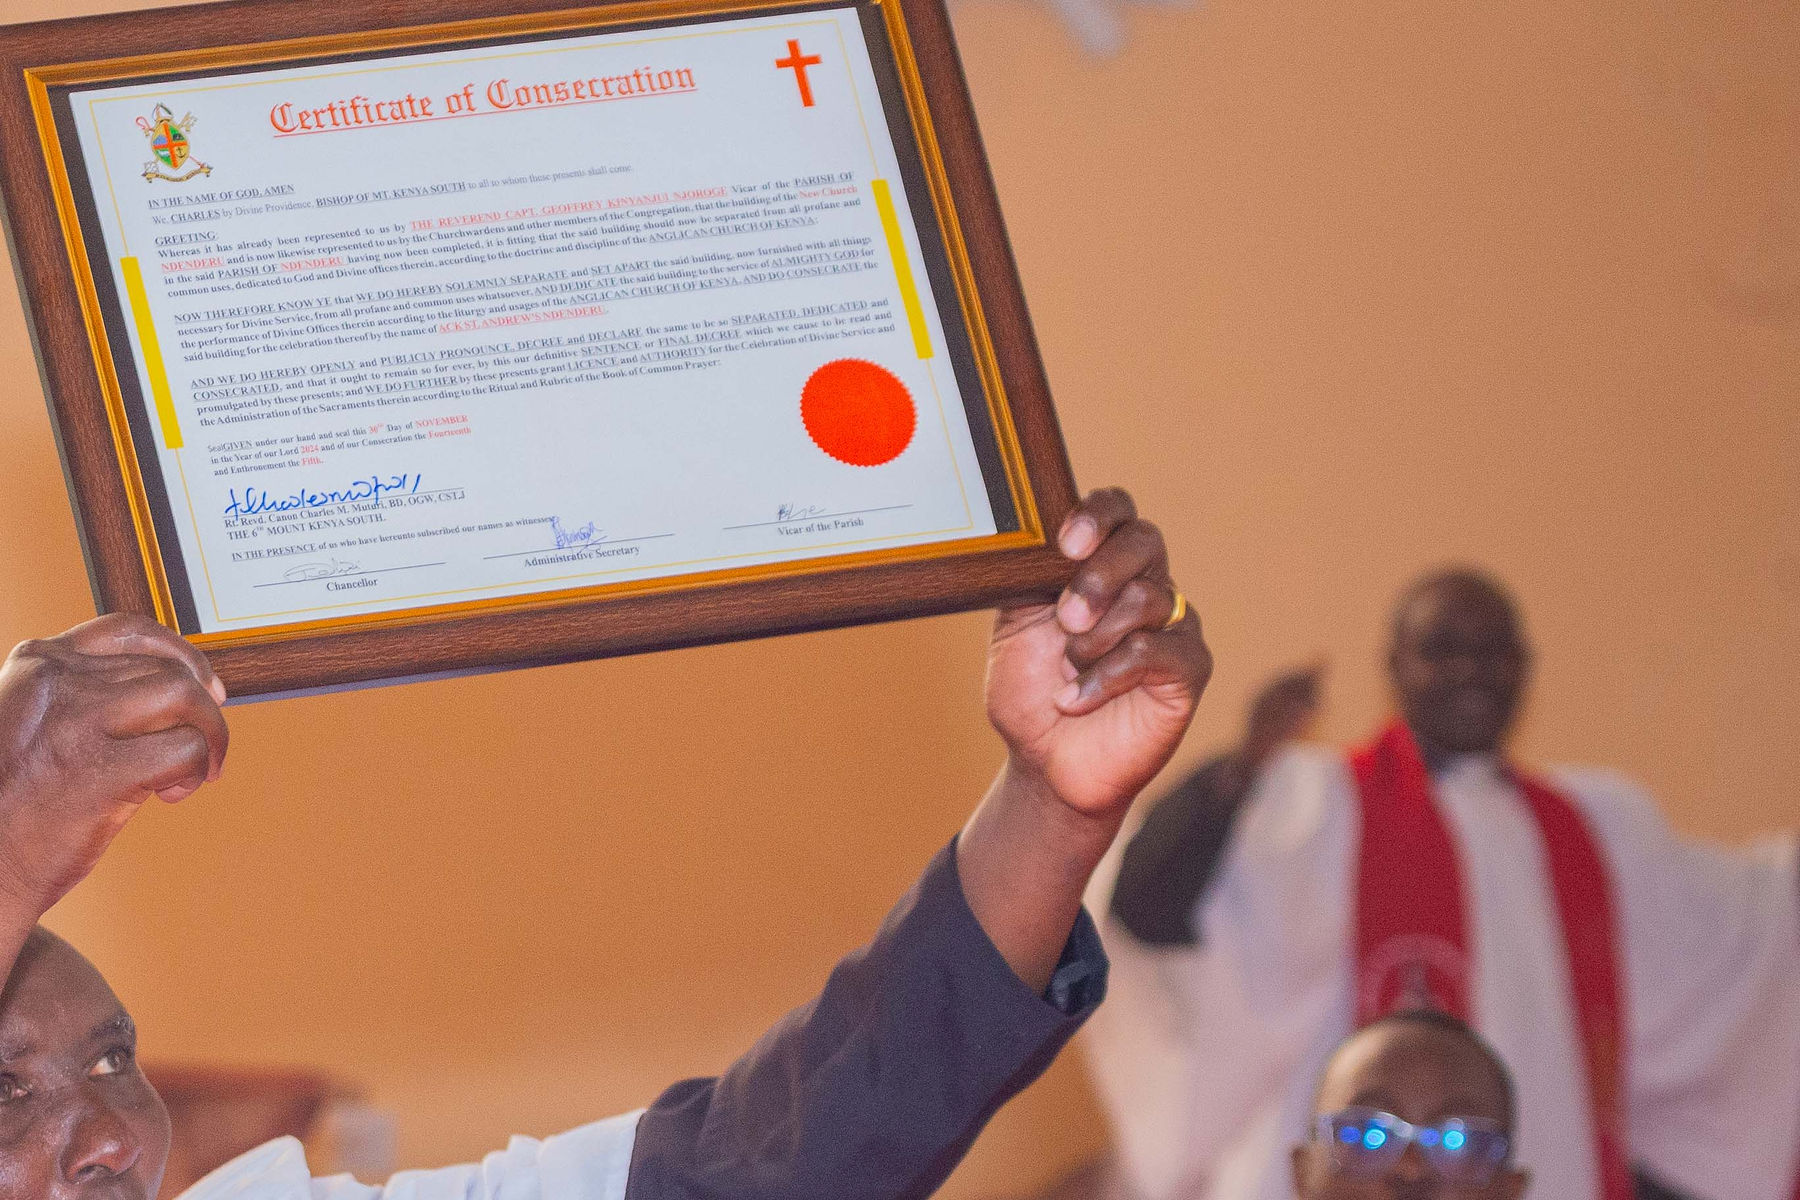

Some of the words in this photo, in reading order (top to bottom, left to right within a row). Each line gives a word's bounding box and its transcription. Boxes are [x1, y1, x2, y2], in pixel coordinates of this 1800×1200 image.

[269, 94, 434, 135] Certificate
[445, 83, 479, 117] of
[486, 65, 697, 111] Consecration
[184, 193, 218, 204] NAME
[262, 184, 295, 195] AMEN
[203, 304, 275, 319] THEREFORE
[274, 299, 314, 310] KNOW
[333, 295, 354, 304] that
[394, 285, 443, 297] HEREBY
[443, 277, 508, 291] SOLEMNLY
[508, 270, 569, 284] SEPARATE
[613, 261, 649, 272] APART
[668, 256, 690, 265] said
[754, 243, 804, 255] furnished
[802, 241, 827, 250] with
[839, 236, 872, 247] things
[183, 353, 204, 362] said
[203, 348, 246, 361] building
[278, 338, 334, 351] celebration
[333, 334, 369, 344] thereof
[399, 327, 427, 337] name
[258, 367, 308, 379] HEREBY
[307, 361, 356, 373] OPENLY
[378, 352, 437, 365] PUBLICLY
[513, 337, 564, 349] DECREE
[585, 328, 643, 341] DECLARE
[661, 322, 689, 332] same
[799, 301, 869, 316] DEDICATED
[216, 410, 291, 425] Administration
[318, 400, 376, 413] Sacraments
[375, 396, 411, 406] therein
[410, 390, 461, 403] according
[487, 383, 519, 393] Ritual
[537, 377, 574, 387] Rubric
[601, 370, 628, 379] Book
[637, 364, 684, 375] Common
[254, 438, 278, 447] under
[295, 433, 317, 442] hand
[333, 429, 351, 438] seal
[351, 427, 367, 435] this
[413, 415, 469, 428] NOVEMBER
[232, 453, 253, 461] Year
[278, 447, 300, 456] Lord
[298, 445, 320, 454] 2024
[358, 434, 413, 447] Consecration
[229, 461, 287, 474] Enthronement
[265, 522, 307, 535] MOUNT
[307, 518, 346, 530] KENYA
[267, 512, 298, 523] Canon
[297, 507, 336, 519] Charles
[776, 525, 805, 536] Vicar
[813, 521, 833, 532] the
[831, 518, 864, 530] Parish
[265, 543, 317, 556] PRESENCE
[356, 536, 379, 545] have
[378, 531, 416, 543] hereunto
[415, 526, 461, 538] subscribed
[476, 521, 504, 531] names
[523, 550, 595, 567] Administrative
[593, 545, 641, 560] Secretary
[325, 577, 379, 592] Chancellor
